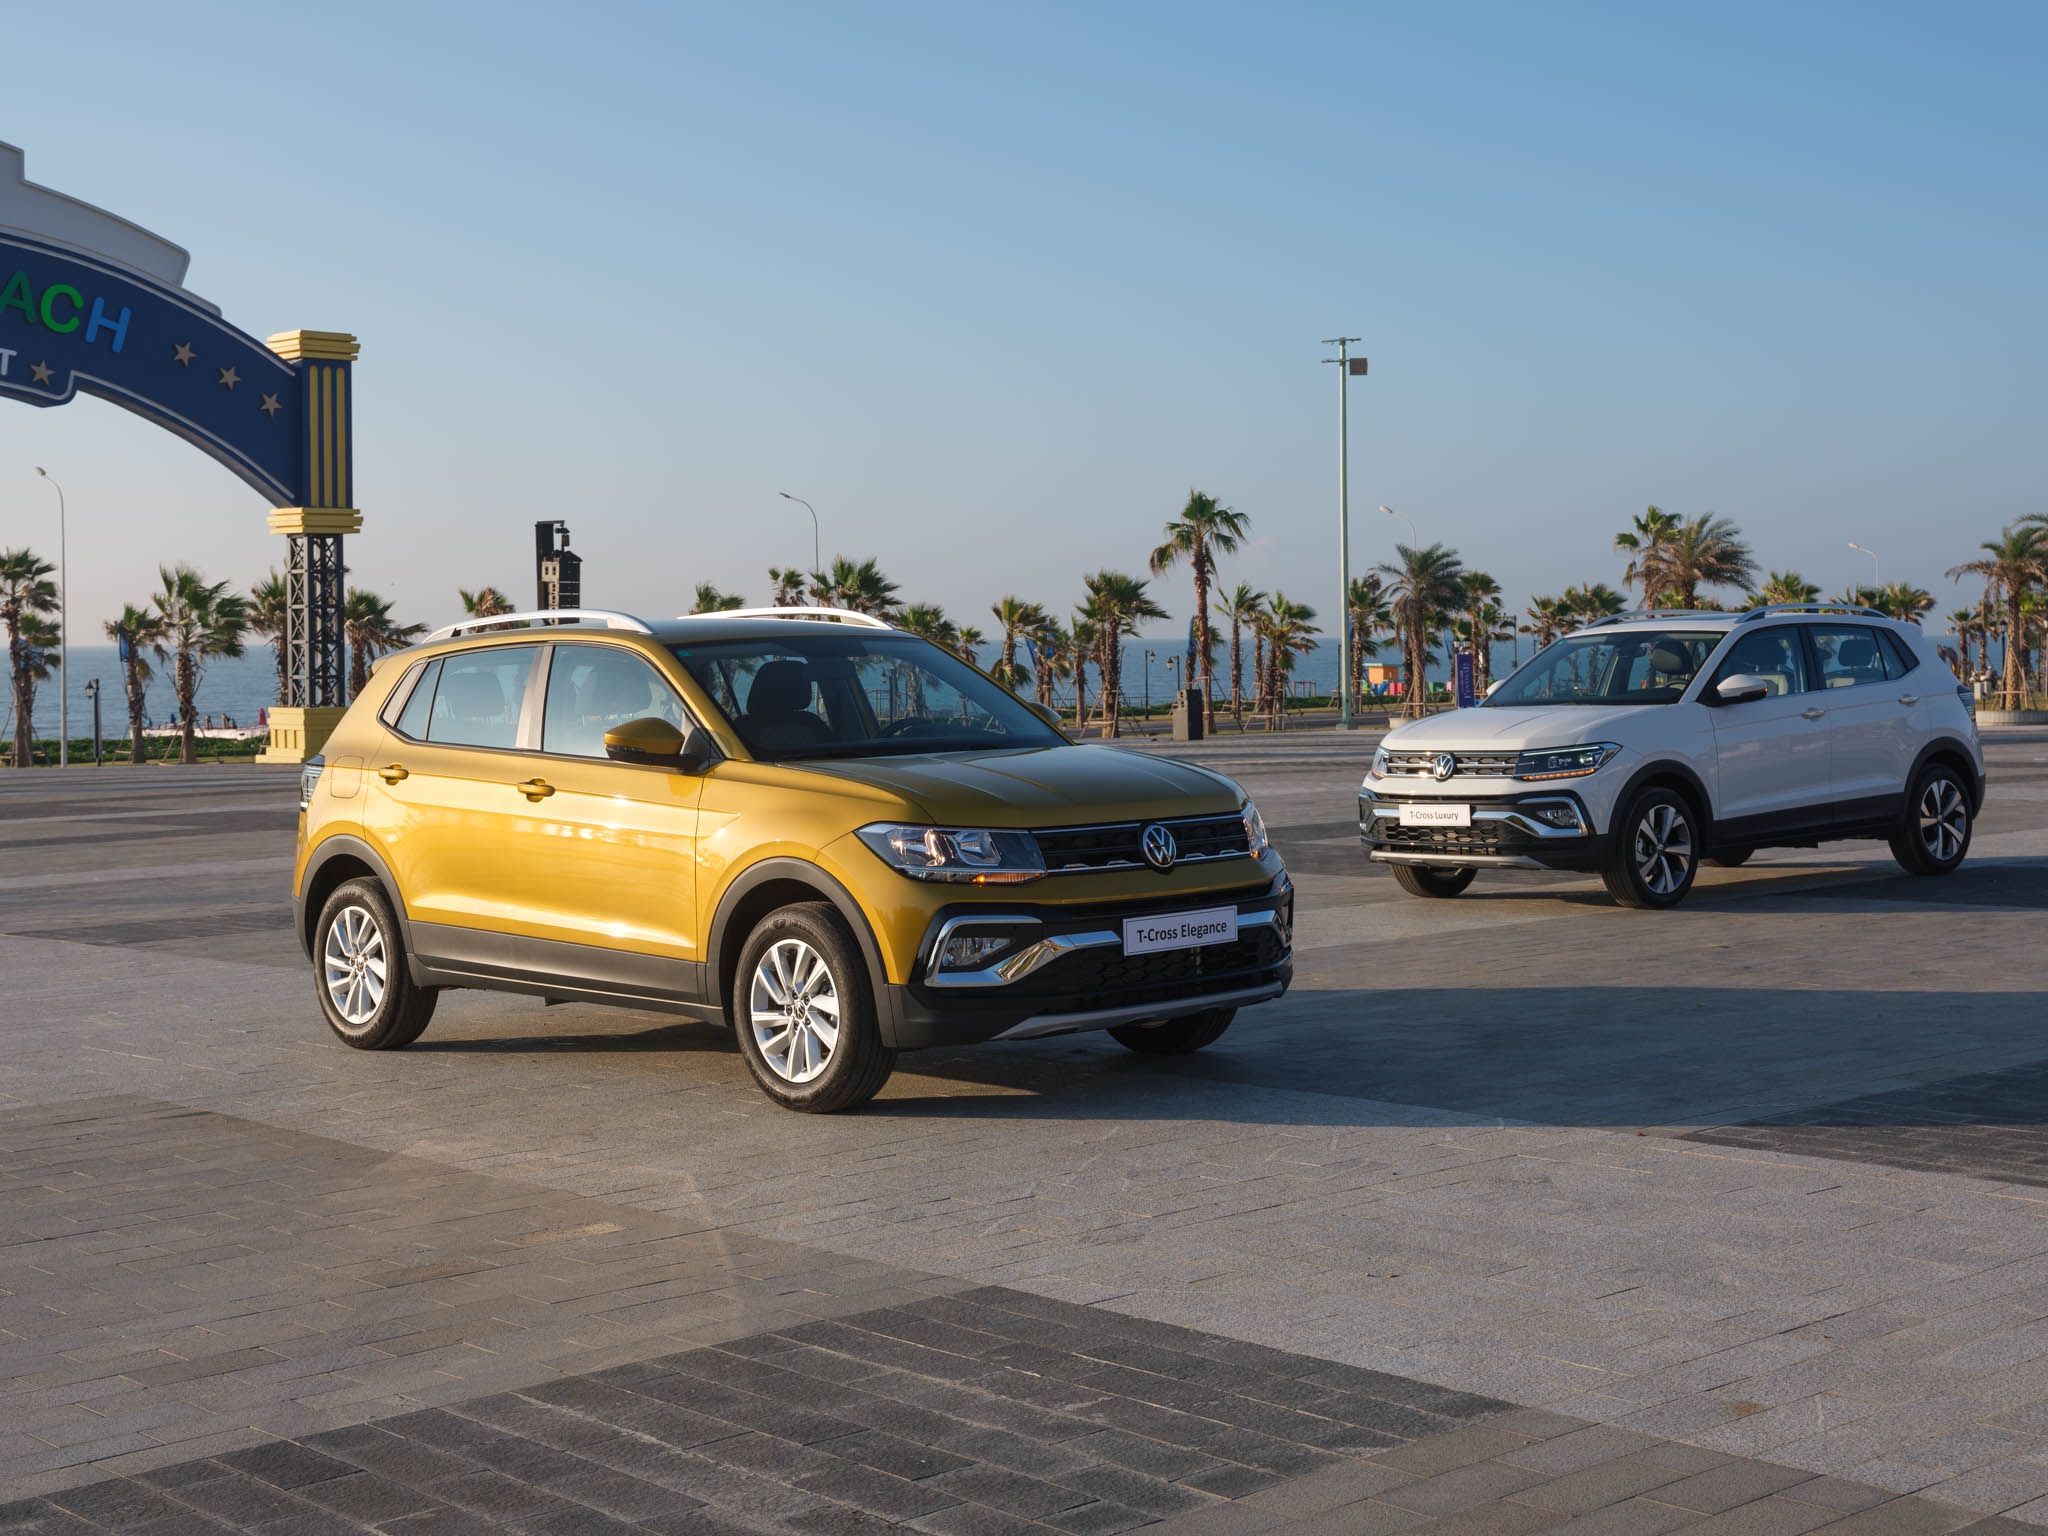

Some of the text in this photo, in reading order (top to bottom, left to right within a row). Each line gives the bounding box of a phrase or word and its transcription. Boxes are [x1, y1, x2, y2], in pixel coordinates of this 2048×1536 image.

[0, 270, 131, 353] ACH
[1410, 811, 1459, 821] T-Cross Luxury
[1137, 922, 1227, 943] T-Cross Elegance
